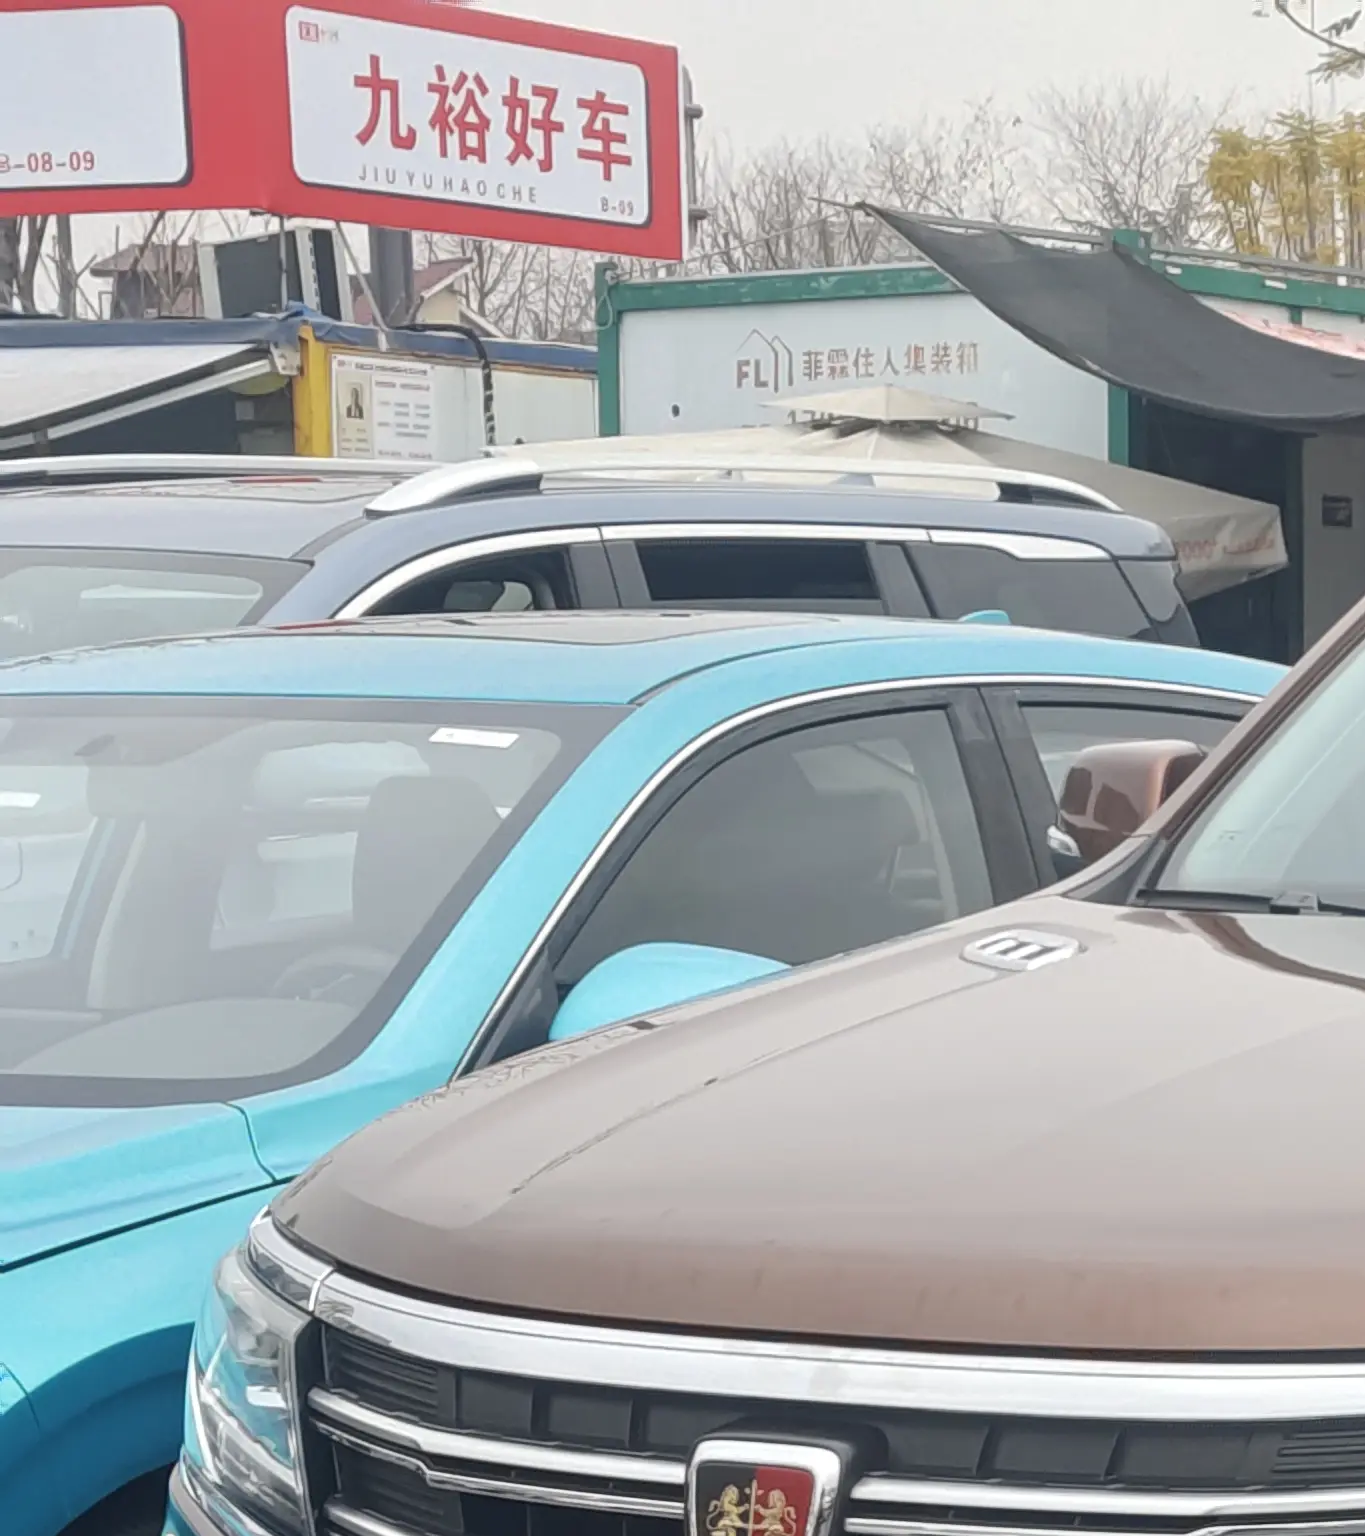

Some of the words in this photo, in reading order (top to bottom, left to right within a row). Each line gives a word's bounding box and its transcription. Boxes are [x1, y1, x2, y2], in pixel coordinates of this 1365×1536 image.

[354, 54, 632, 181] 九裕好车
[600, 196, 634, 217] B-09
